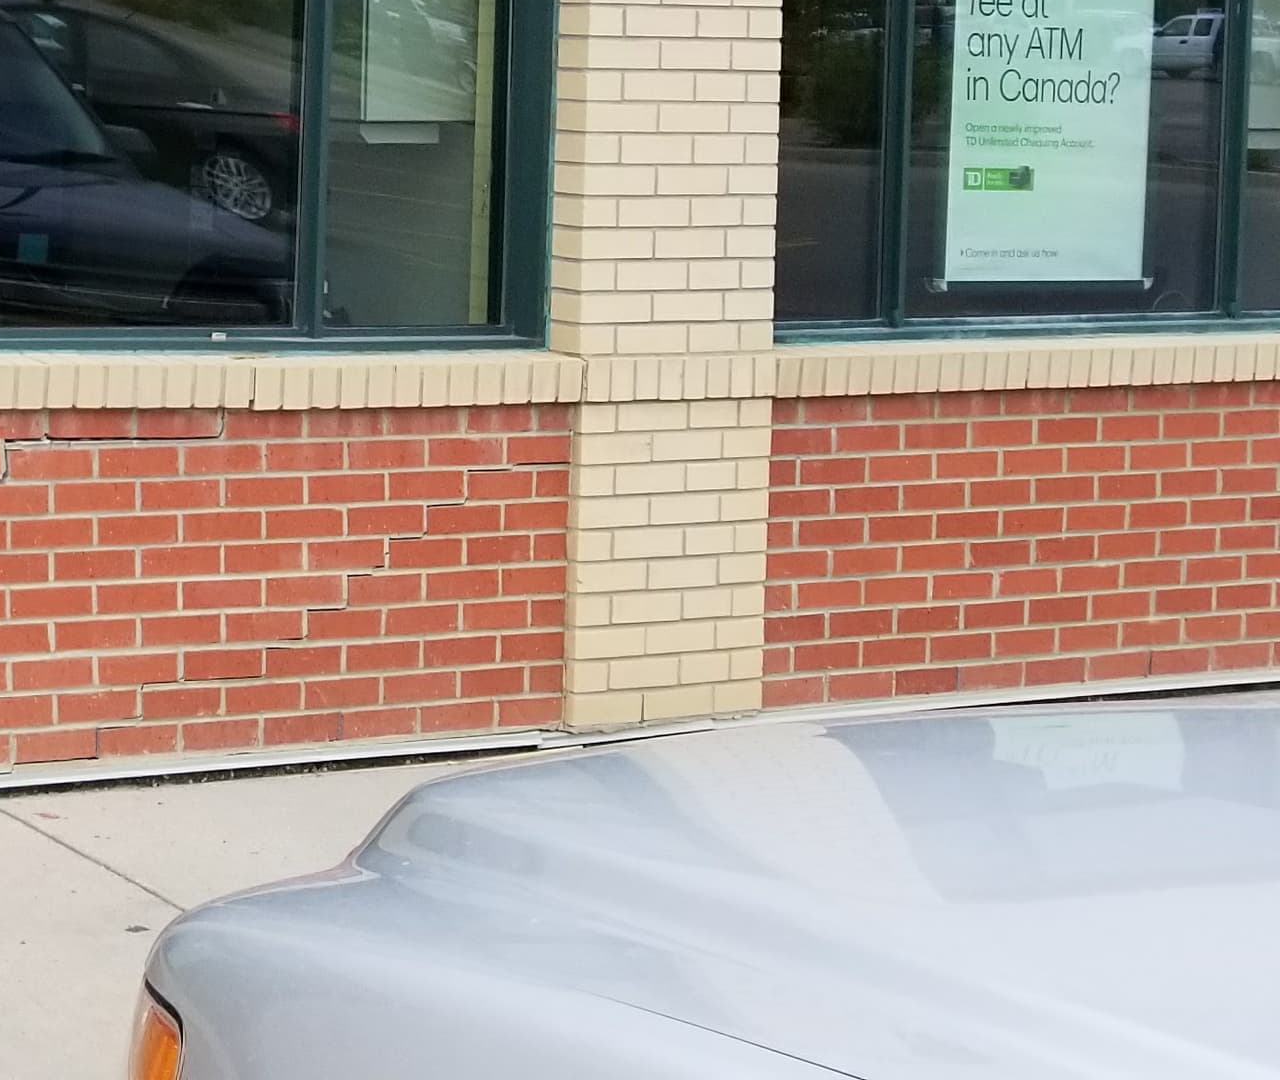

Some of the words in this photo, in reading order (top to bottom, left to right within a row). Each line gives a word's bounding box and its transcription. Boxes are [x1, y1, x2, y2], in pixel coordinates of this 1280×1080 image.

[967, 32, 1020, 66] any
[1025, 26, 1084, 61] ATM
[966, 67, 989, 102] in
[999, 68, 1121, 105] Canada?
[965, 171, 981, 186] TD
